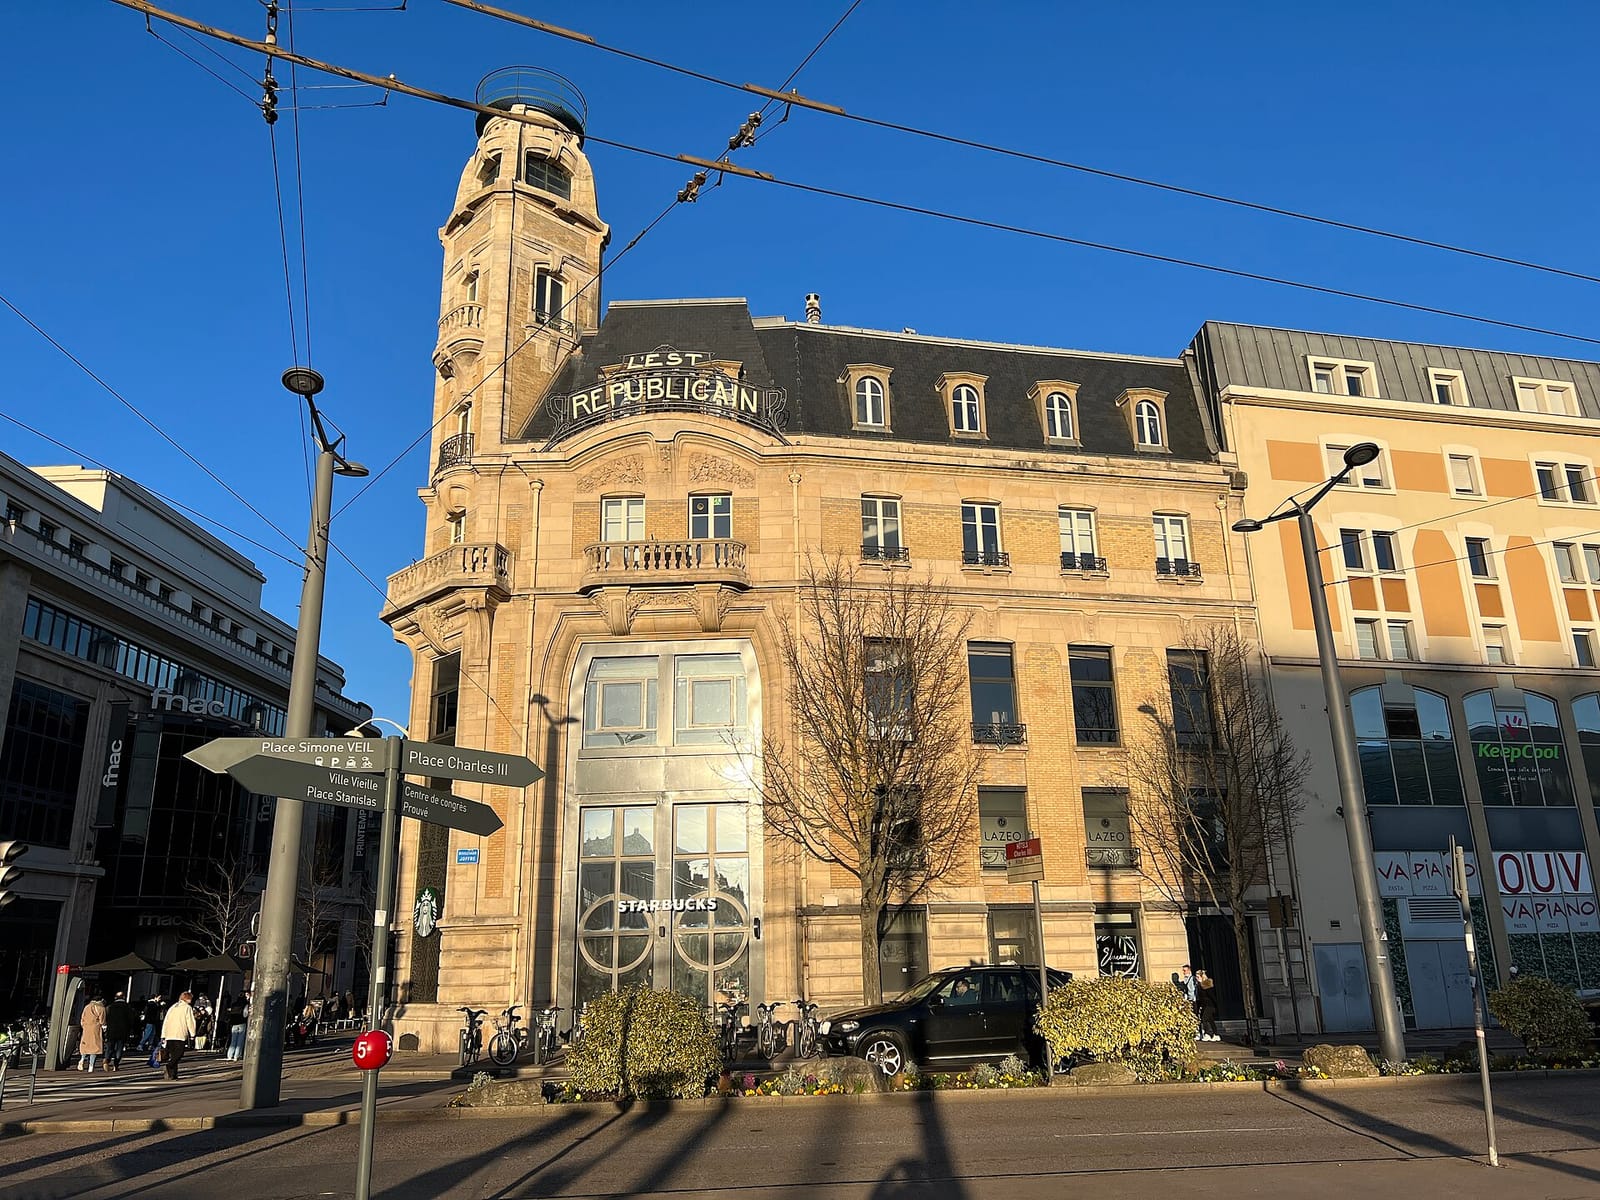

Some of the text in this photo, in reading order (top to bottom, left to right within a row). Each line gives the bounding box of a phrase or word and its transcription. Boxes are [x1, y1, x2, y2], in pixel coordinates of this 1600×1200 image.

[627, 353, 703, 370] L'EST
[571, 376, 758, 420] REPUBLICAIN
[151, 687, 225, 717] fnac
[261, 741, 374, 753] Place Simone VEIL
[1478, 743, 1560, 763] KeepCool
[102, 739, 123, 788] fnac
[409, 750, 508, 776] Place Charles III
[329, 772, 378, 791] Ville Vieille
[307, 785, 377, 807] Place Stanislas
[404, 786, 467, 813] Centre de congrès
[257, 795, 271, 823] fna
[402, 801, 429, 817] Prouvé
[355, 809, 368, 857] PRINTEMP
[984, 831, 1022, 841] LAZEO
[1088, 831, 1125, 841] LAZEO
[1498, 853, 1582, 894] OUV
[617, 897, 717, 913] STARBUCKS
[357, 1041, 368, 1059] 5
